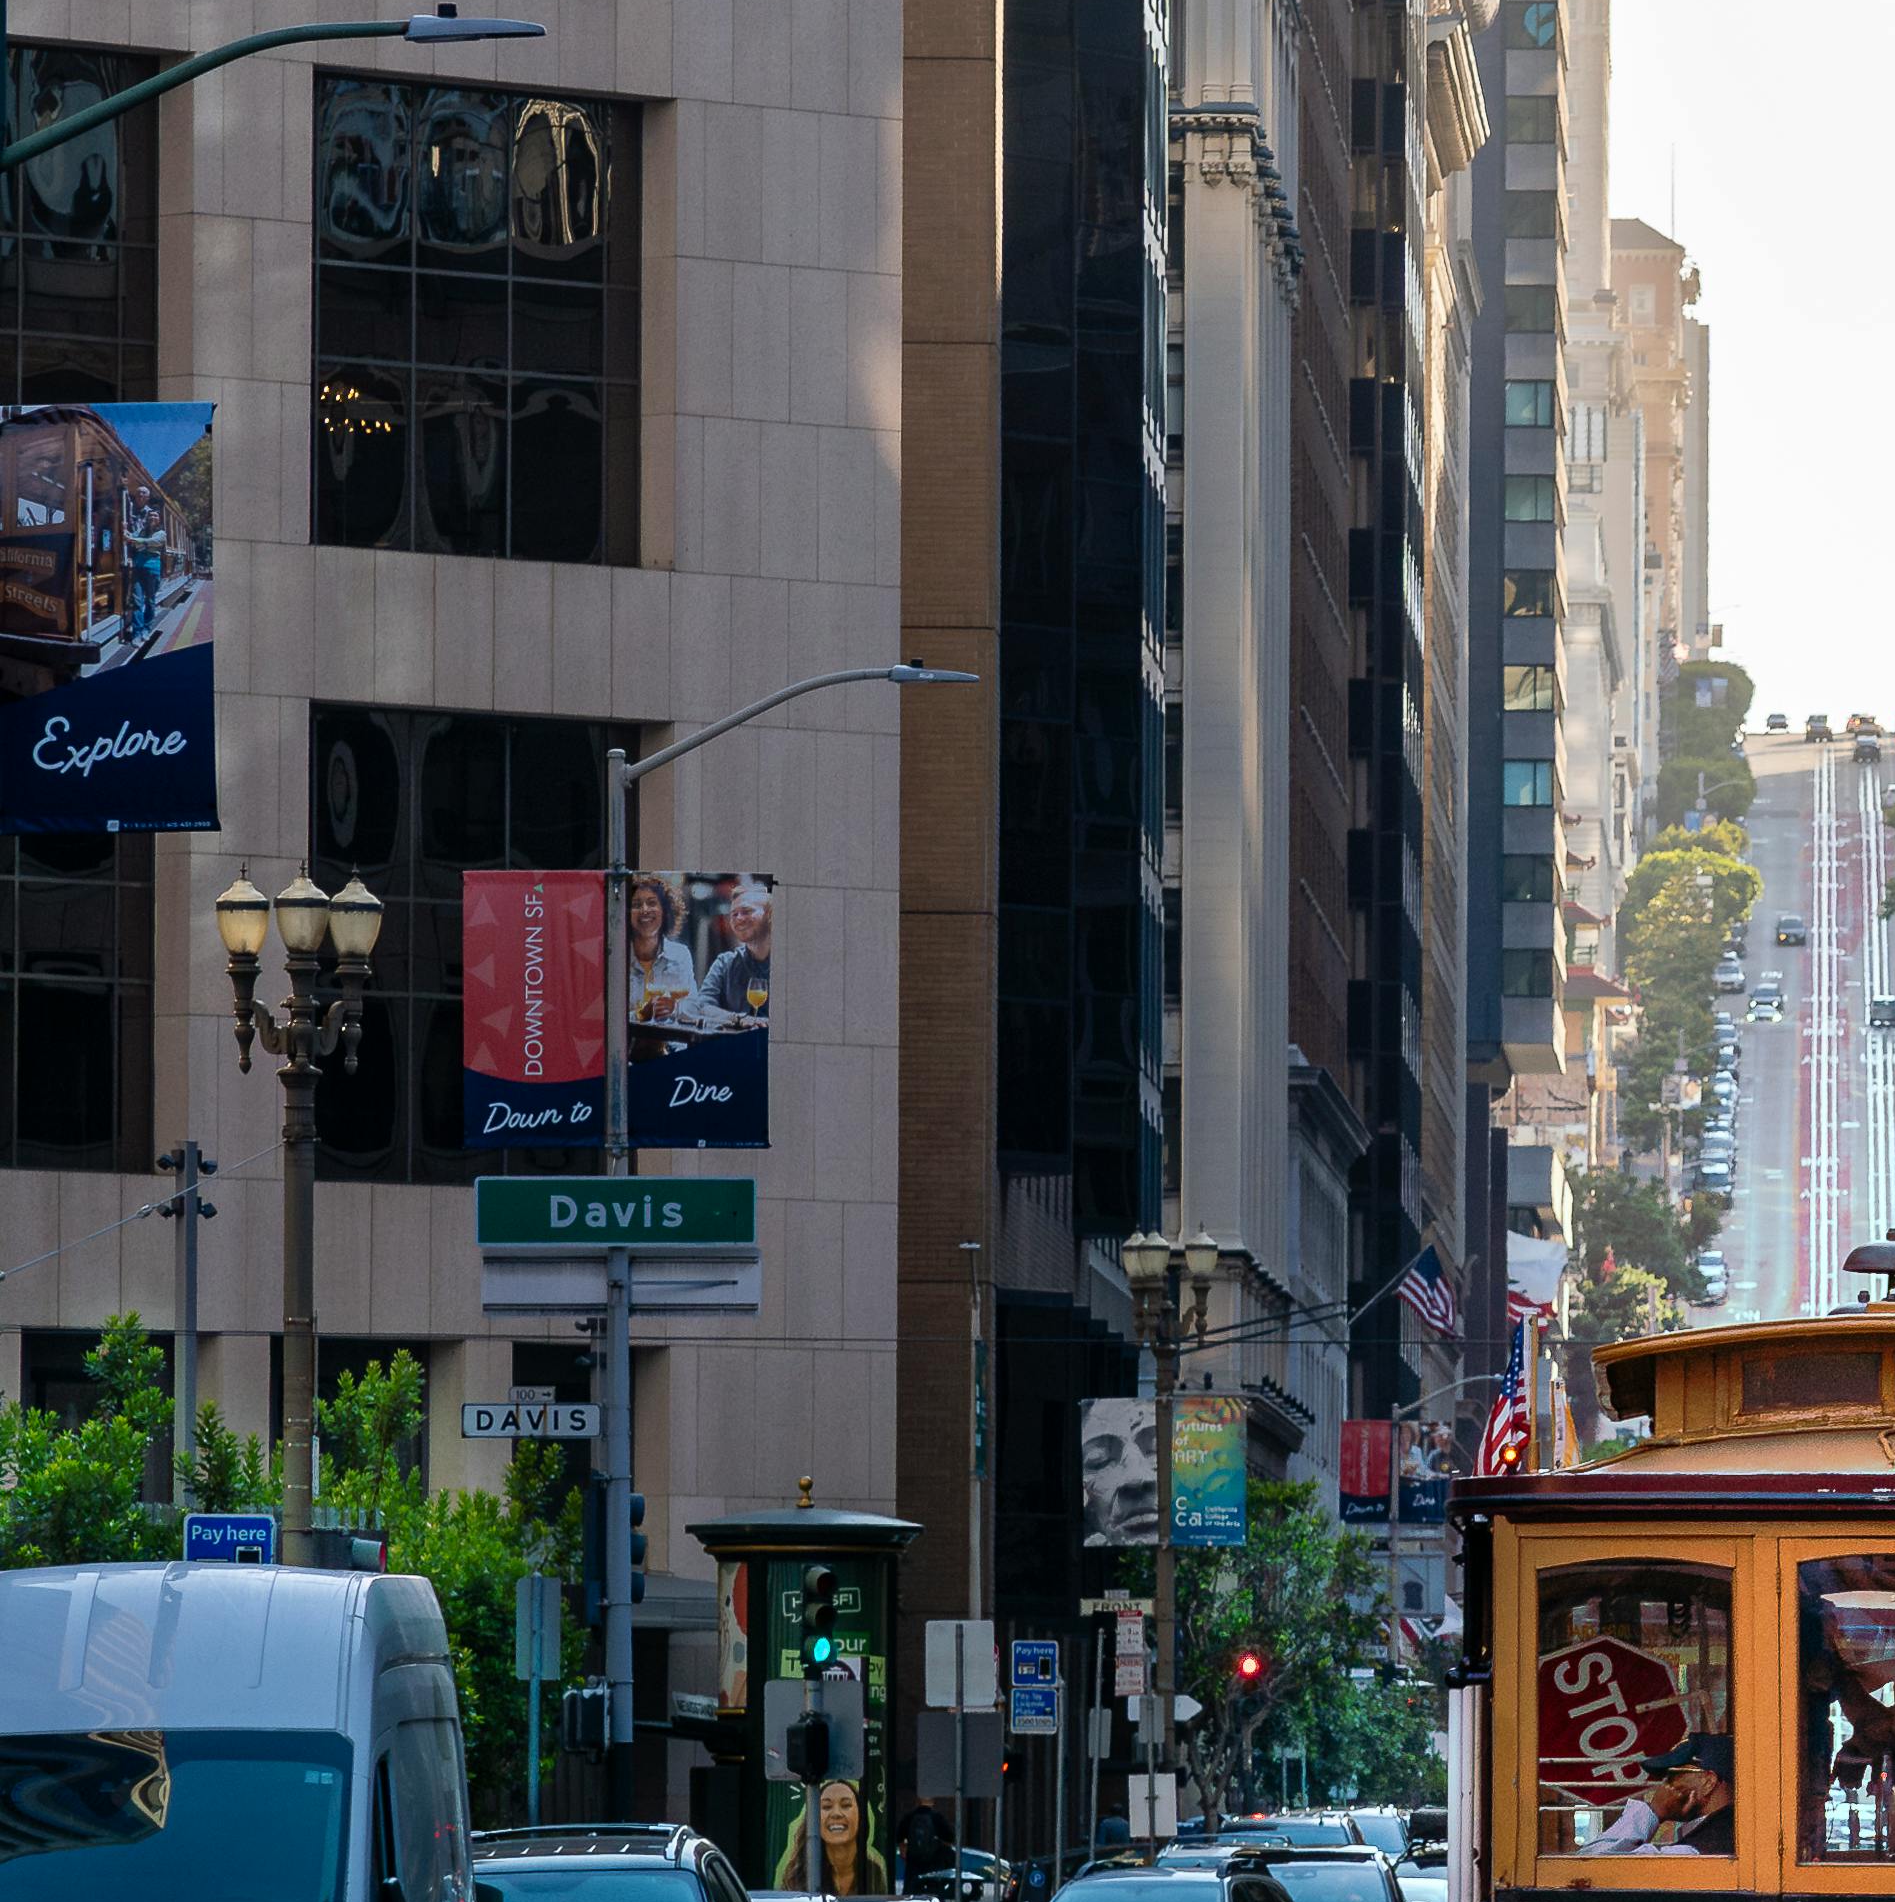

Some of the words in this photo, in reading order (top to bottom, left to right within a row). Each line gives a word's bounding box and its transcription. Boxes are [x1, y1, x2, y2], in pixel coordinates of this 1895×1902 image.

[33, 716, 187, 777] Explore
[524, 894, 544, 918] SF
[524, 926, 544, 1076] DOWNTOWN
[669, 1075, 733, 1108] Dine
[483, 1102, 563, 1134] Down
[570, 1101, 592, 1121] to
[550, 1195, 684, 1229] Davis
[516, 1389, 535, 1400] 100
[476, 1409, 587, 1432] DAVIS
[1175, 1420, 1223, 1433] Futures
[191, 1525, 224, 1545] Pay
[227, 1524, 267, 1541] here
[1554, 1652, 1650, 1786] STOP
